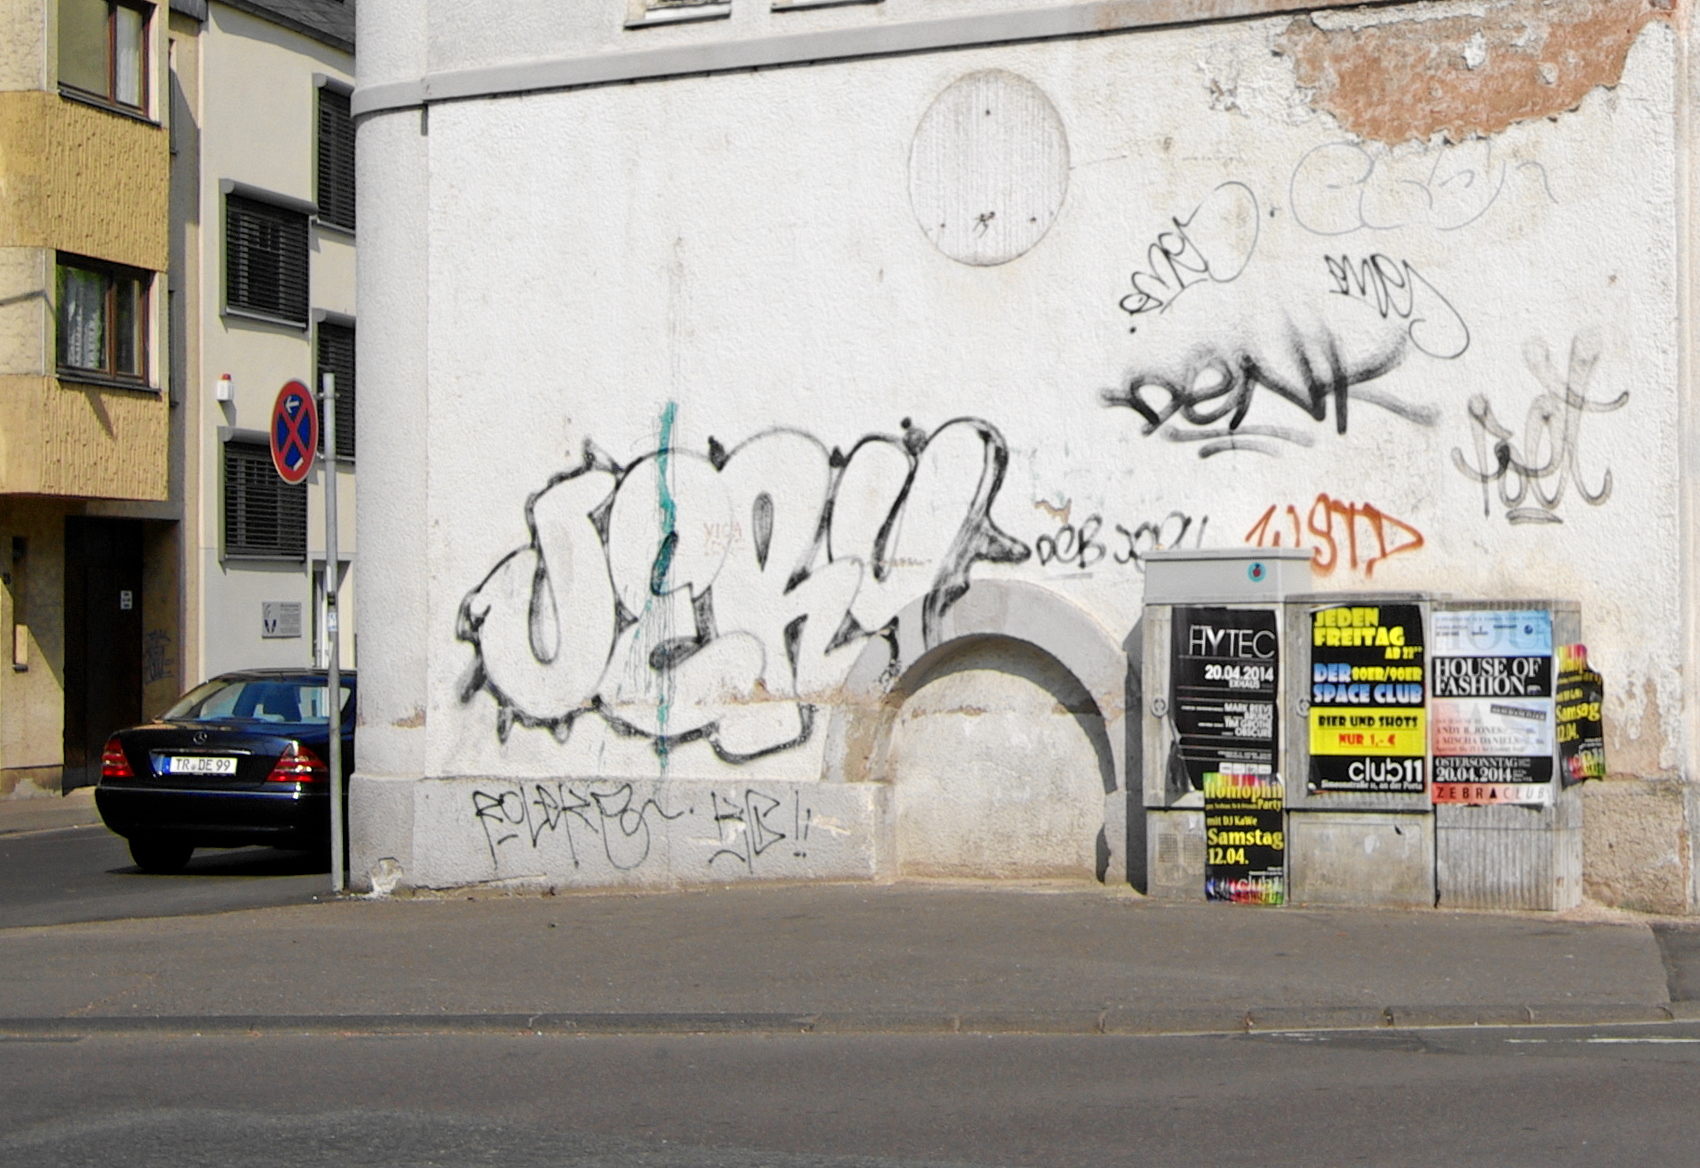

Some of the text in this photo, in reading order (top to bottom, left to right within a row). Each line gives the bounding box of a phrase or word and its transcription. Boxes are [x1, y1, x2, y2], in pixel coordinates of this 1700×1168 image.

[1314, 606, 1380, 627] JEDEN
[1189, 624, 1276, 659] HYTEC
[1313, 626, 1405, 647] FREITAG
[1384, 646, 1401, 660] AB
[1204, 664, 1274, 682] 20.04.2014
[1313, 663, 1423, 683] DER 80ER/90ER
[1434, 657, 1508, 678] HOUSE
[1512, 657, 1542, 678] OF
[1313, 683, 1423, 704] SPACE CLUB
[1434, 676, 1525, 696] FASHION
[1318, 715, 1418, 728] BIER UND SHOTS
[1338, 733, 1364, 745] NUR
[216, 759, 231, 772] 99
[1348, 756, 1423, 783] club11
[1435, 757, 1518, 768] OSTERSONNTAG
[1436, 767, 1512, 782] 20.04.2014
[1436, 786, 1545, 800] ZEBRA CLUB
[1257, 798, 1282, 812] Party
[1222, 816, 1234, 826] DJ
[1207, 827, 1285, 850] Samstag
[1208, 847, 1249, 865] 12.04.
